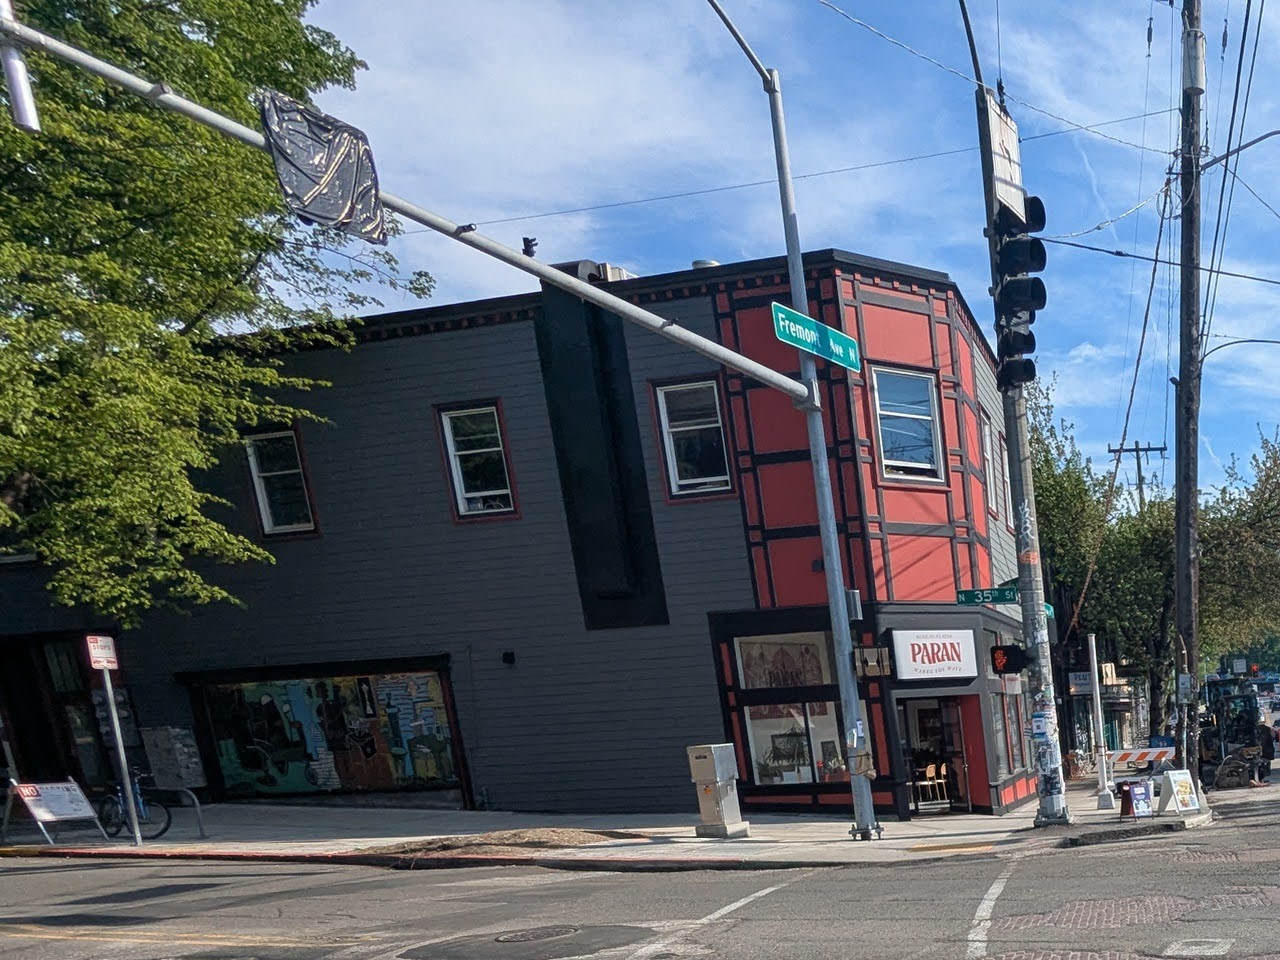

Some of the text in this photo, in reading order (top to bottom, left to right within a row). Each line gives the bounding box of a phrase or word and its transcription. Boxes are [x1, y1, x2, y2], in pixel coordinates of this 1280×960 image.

[778, 312, 856, 363] Fremont Ave N
[958, 590, 1014, 602] N 35th St
[910, 642, 962, 665] PARAN
[20, 786, 38, 797] NO
